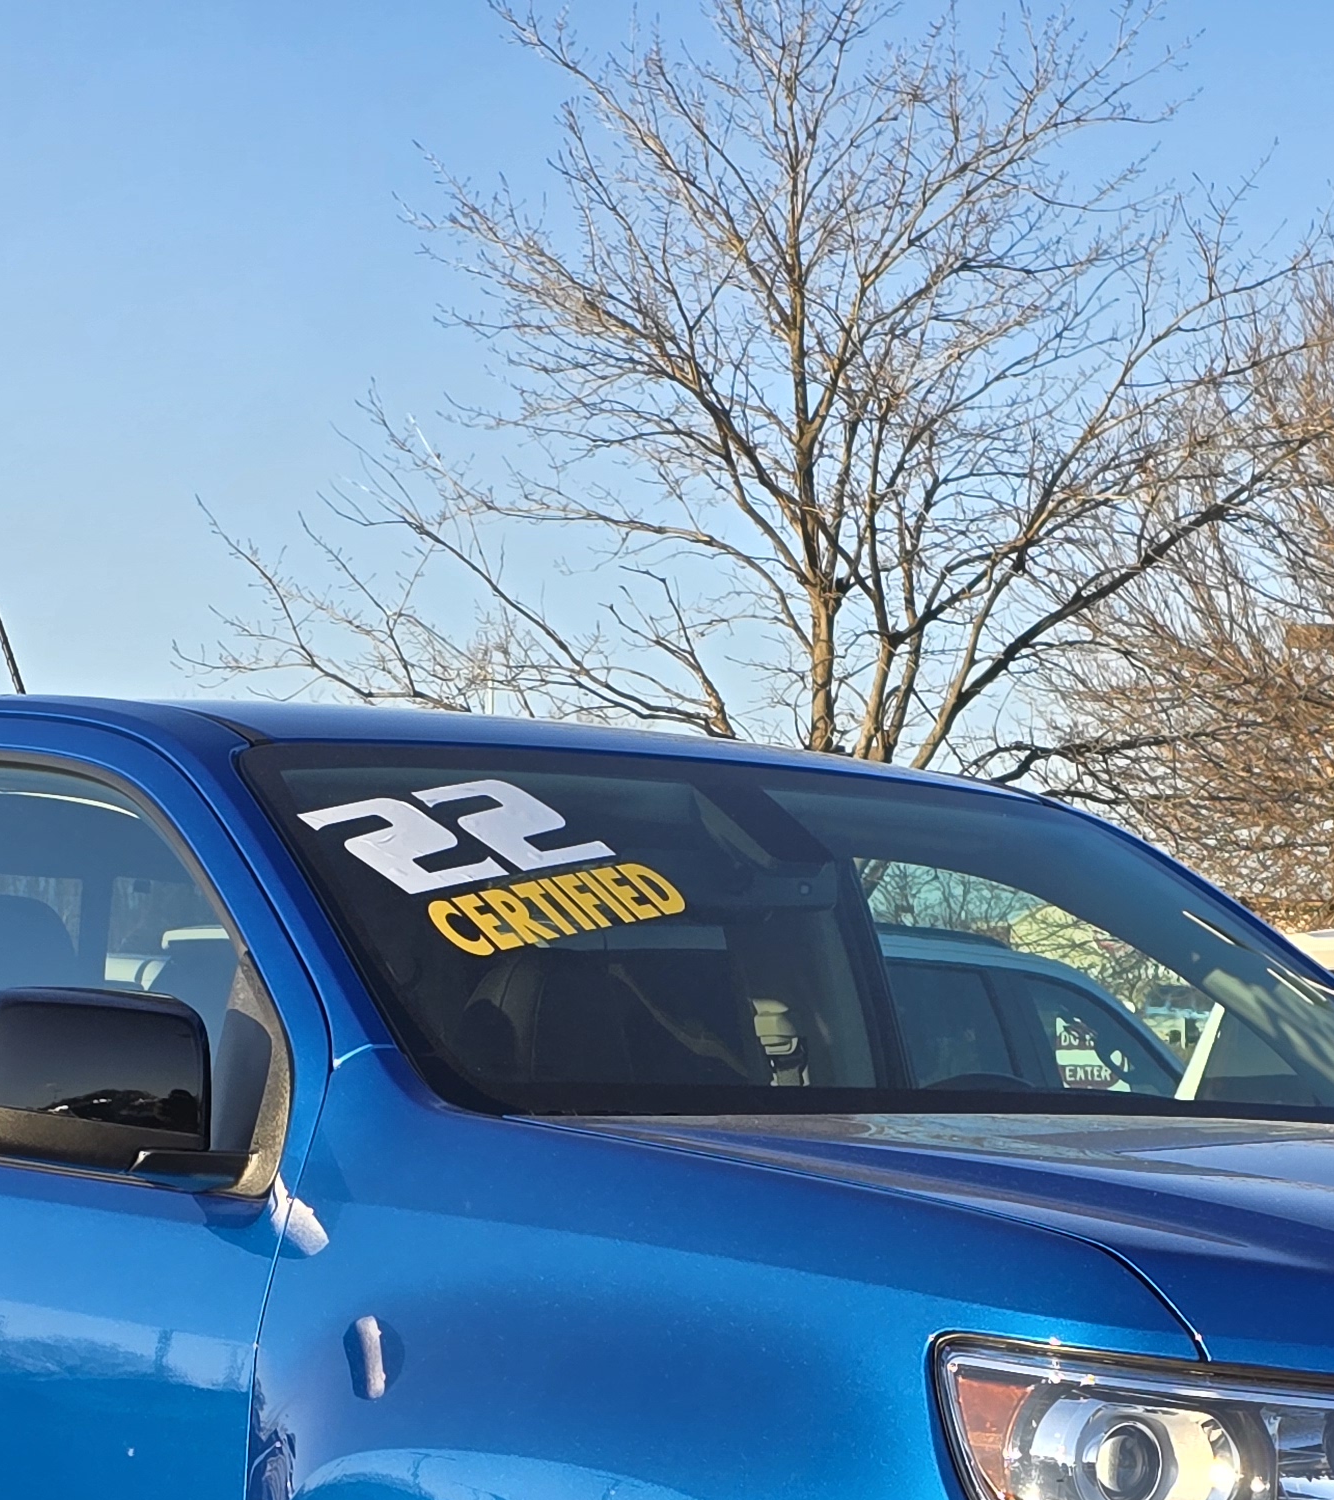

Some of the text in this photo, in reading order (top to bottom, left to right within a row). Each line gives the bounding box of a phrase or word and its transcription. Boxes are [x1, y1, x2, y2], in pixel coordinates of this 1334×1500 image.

[297, 779, 615, 894] 22
[428, 863, 685, 956] CERTIFIED
[1066, 1066, 1111, 1081] ENTER
